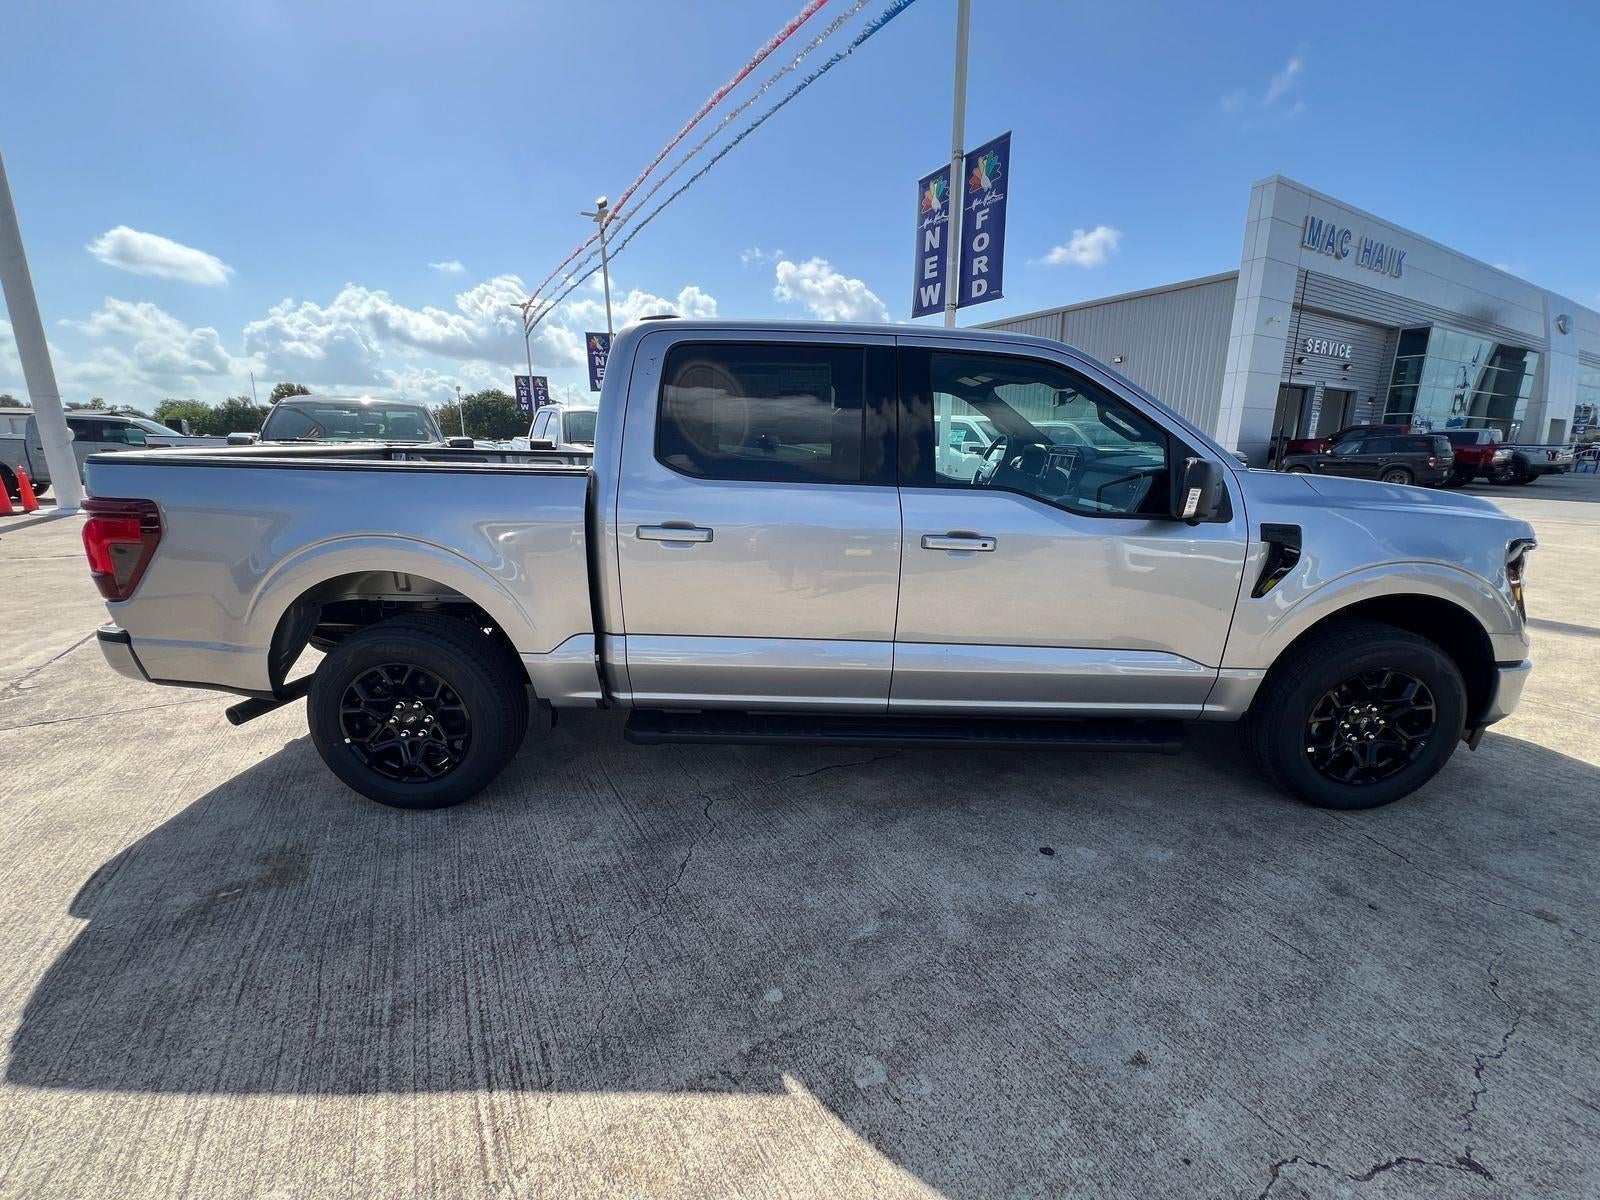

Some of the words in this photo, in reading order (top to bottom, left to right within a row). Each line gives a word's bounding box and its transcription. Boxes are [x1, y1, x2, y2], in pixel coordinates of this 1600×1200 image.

[919, 226, 941, 307] NEW
[971, 207, 990, 298] FORD
[1306, 215, 1352, 258] MAC
[1359, 236, 1407, 276] HAIK
[1306, 338, 1352, 358] SERVICE
[520, 389, 529, 410] NEW
